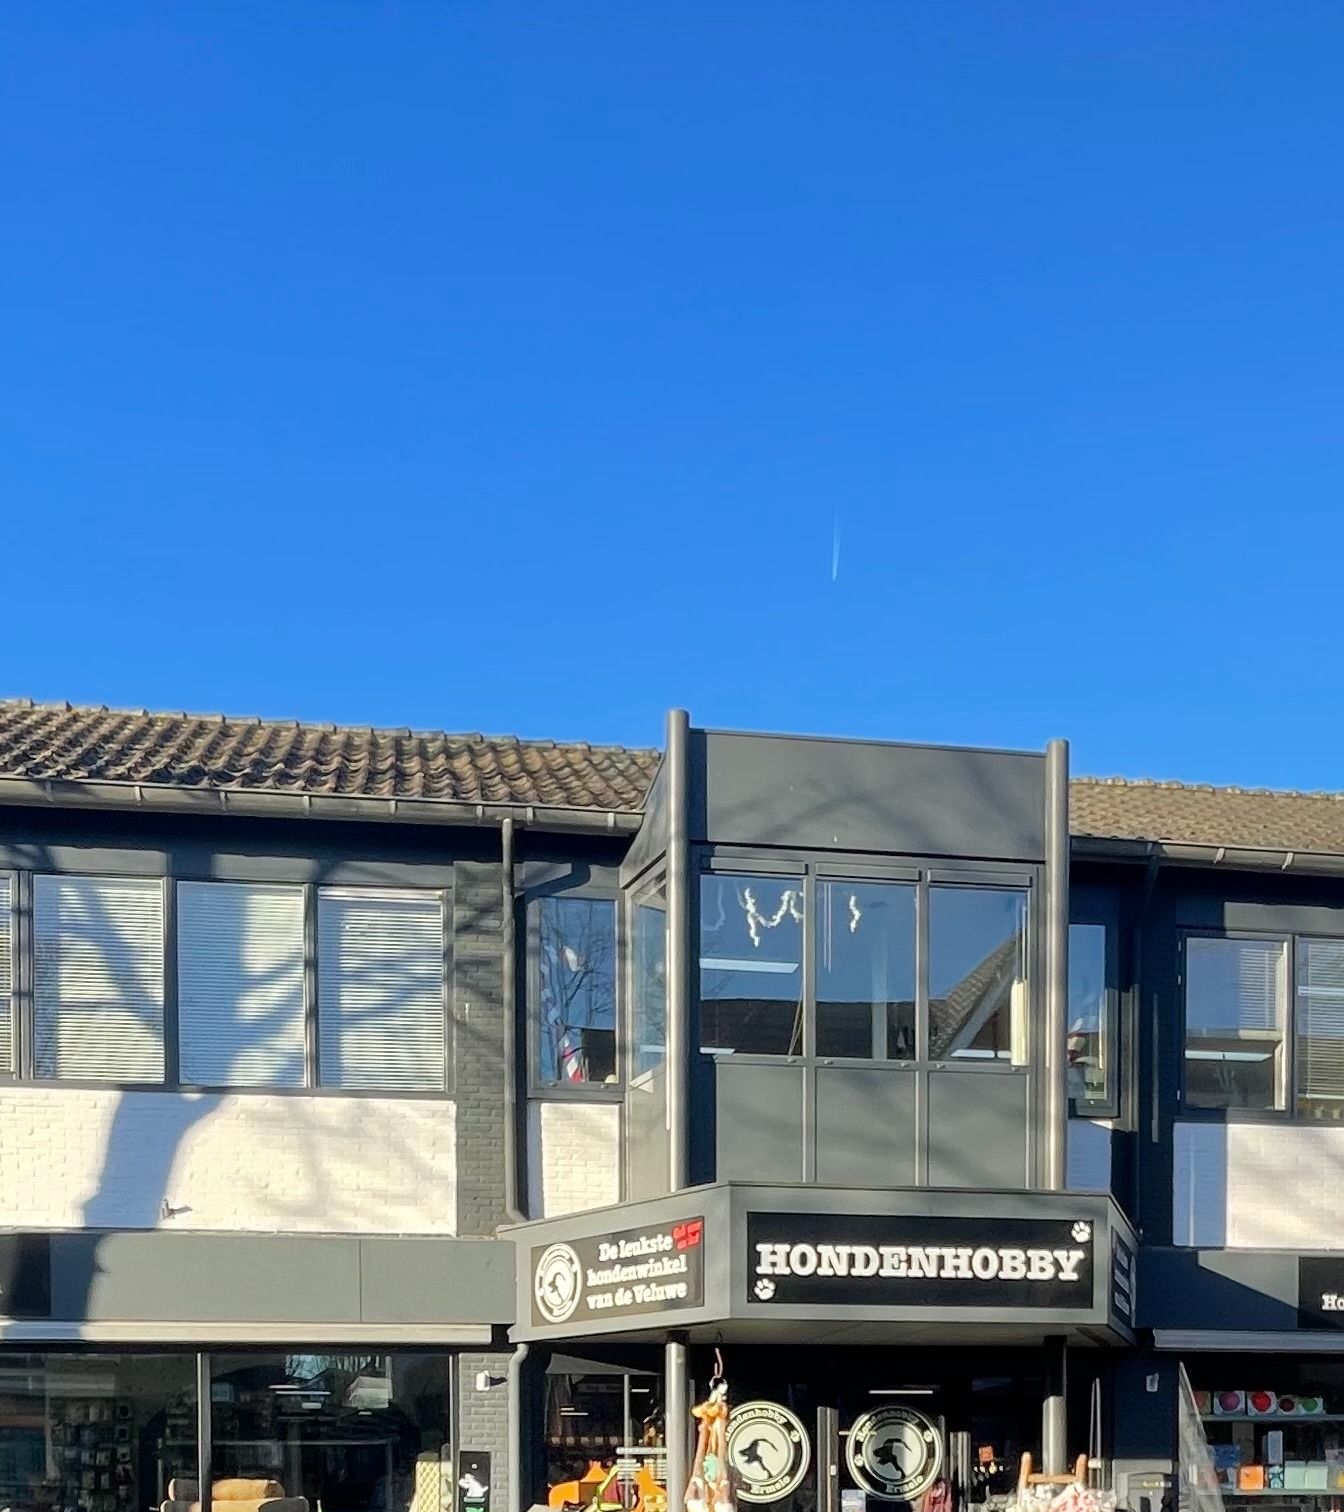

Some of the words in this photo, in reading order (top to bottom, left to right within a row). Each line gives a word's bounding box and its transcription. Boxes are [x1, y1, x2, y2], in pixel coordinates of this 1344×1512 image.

[598, 1243, 618, 1262] De
[619, 1234, 673, 1258] leukste
[755, 1243, 1085, 1281] HONDENHOBBY
[586, 1254, 688, 1287] hondenwinkel
[586, 1293, 613, 1310] van
[615, 1287, 632, 1306] de
[633, 1282, 688, 1303] Veluwe
